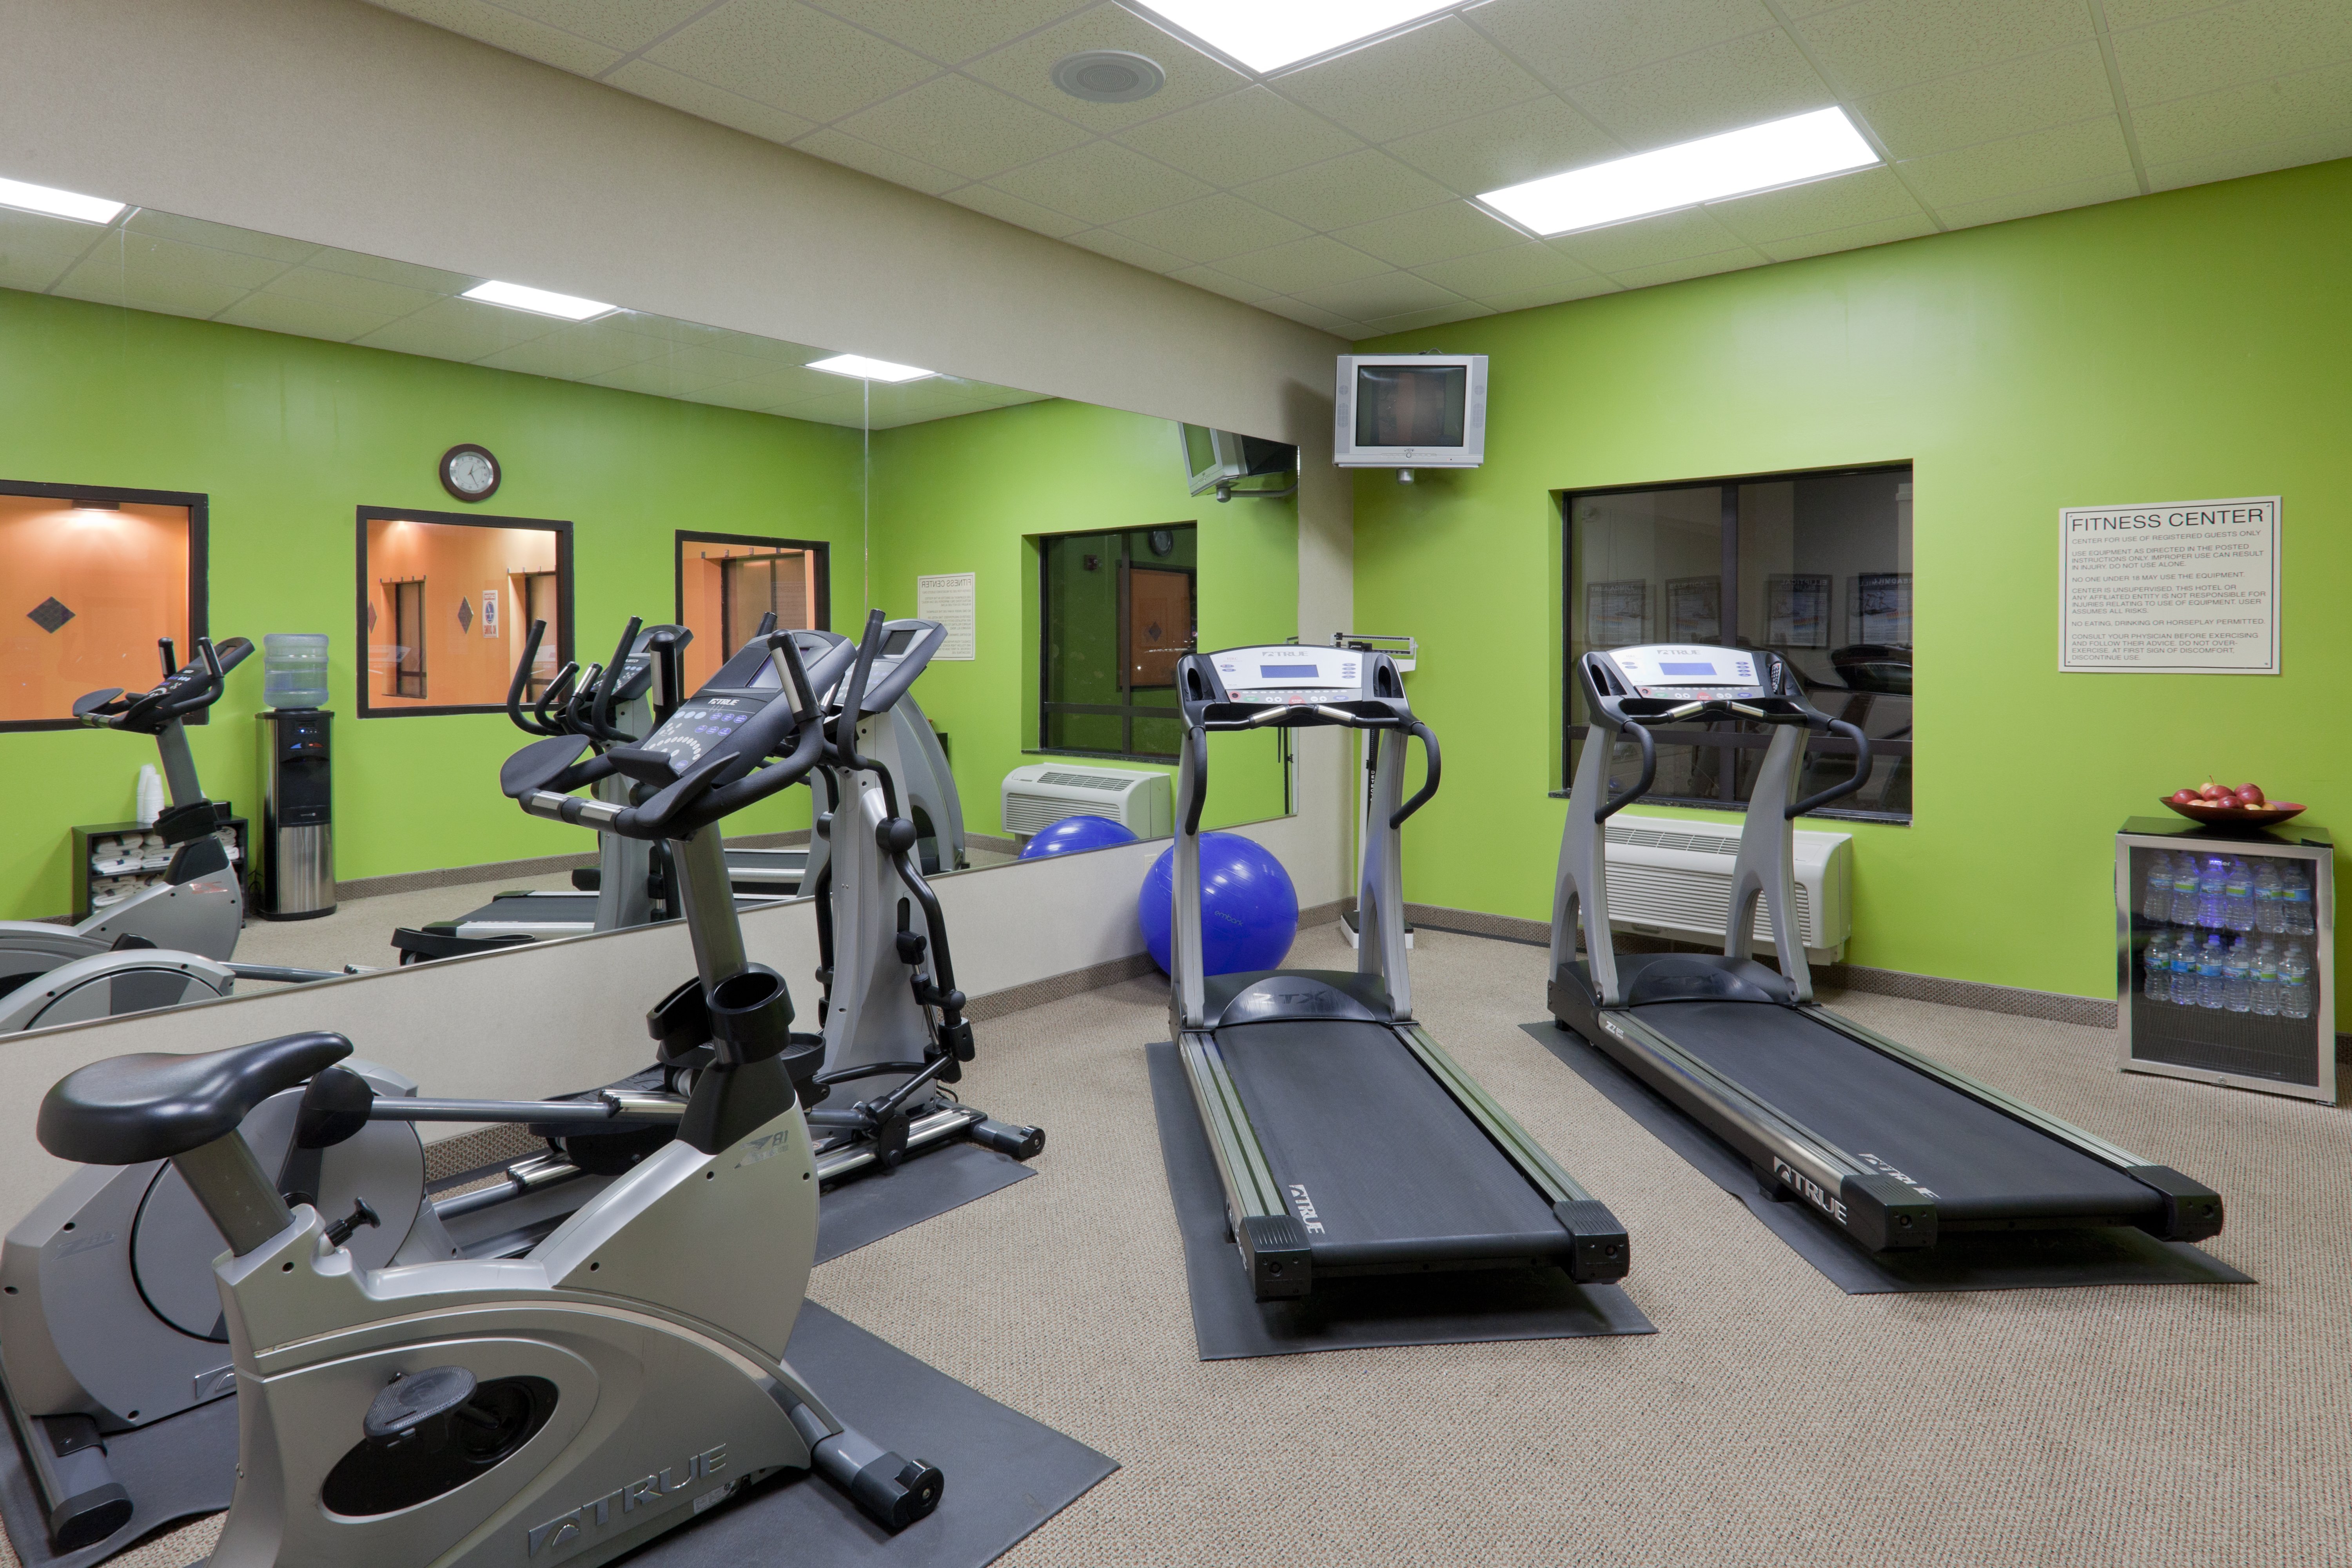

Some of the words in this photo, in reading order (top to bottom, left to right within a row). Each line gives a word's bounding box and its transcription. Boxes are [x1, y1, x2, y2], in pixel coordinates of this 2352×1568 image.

[2072, 514, 2161, 532] FITNESS
[2168, 508, 2263, 527] CENTER
[2152, 532, 2202, 541] REGISTERED
[1295, 1196, 1325, 1234] TRUE
[1791, 1168, 1847, 1226] TRUE
[583, 1443, 726, 1526] TRUE
